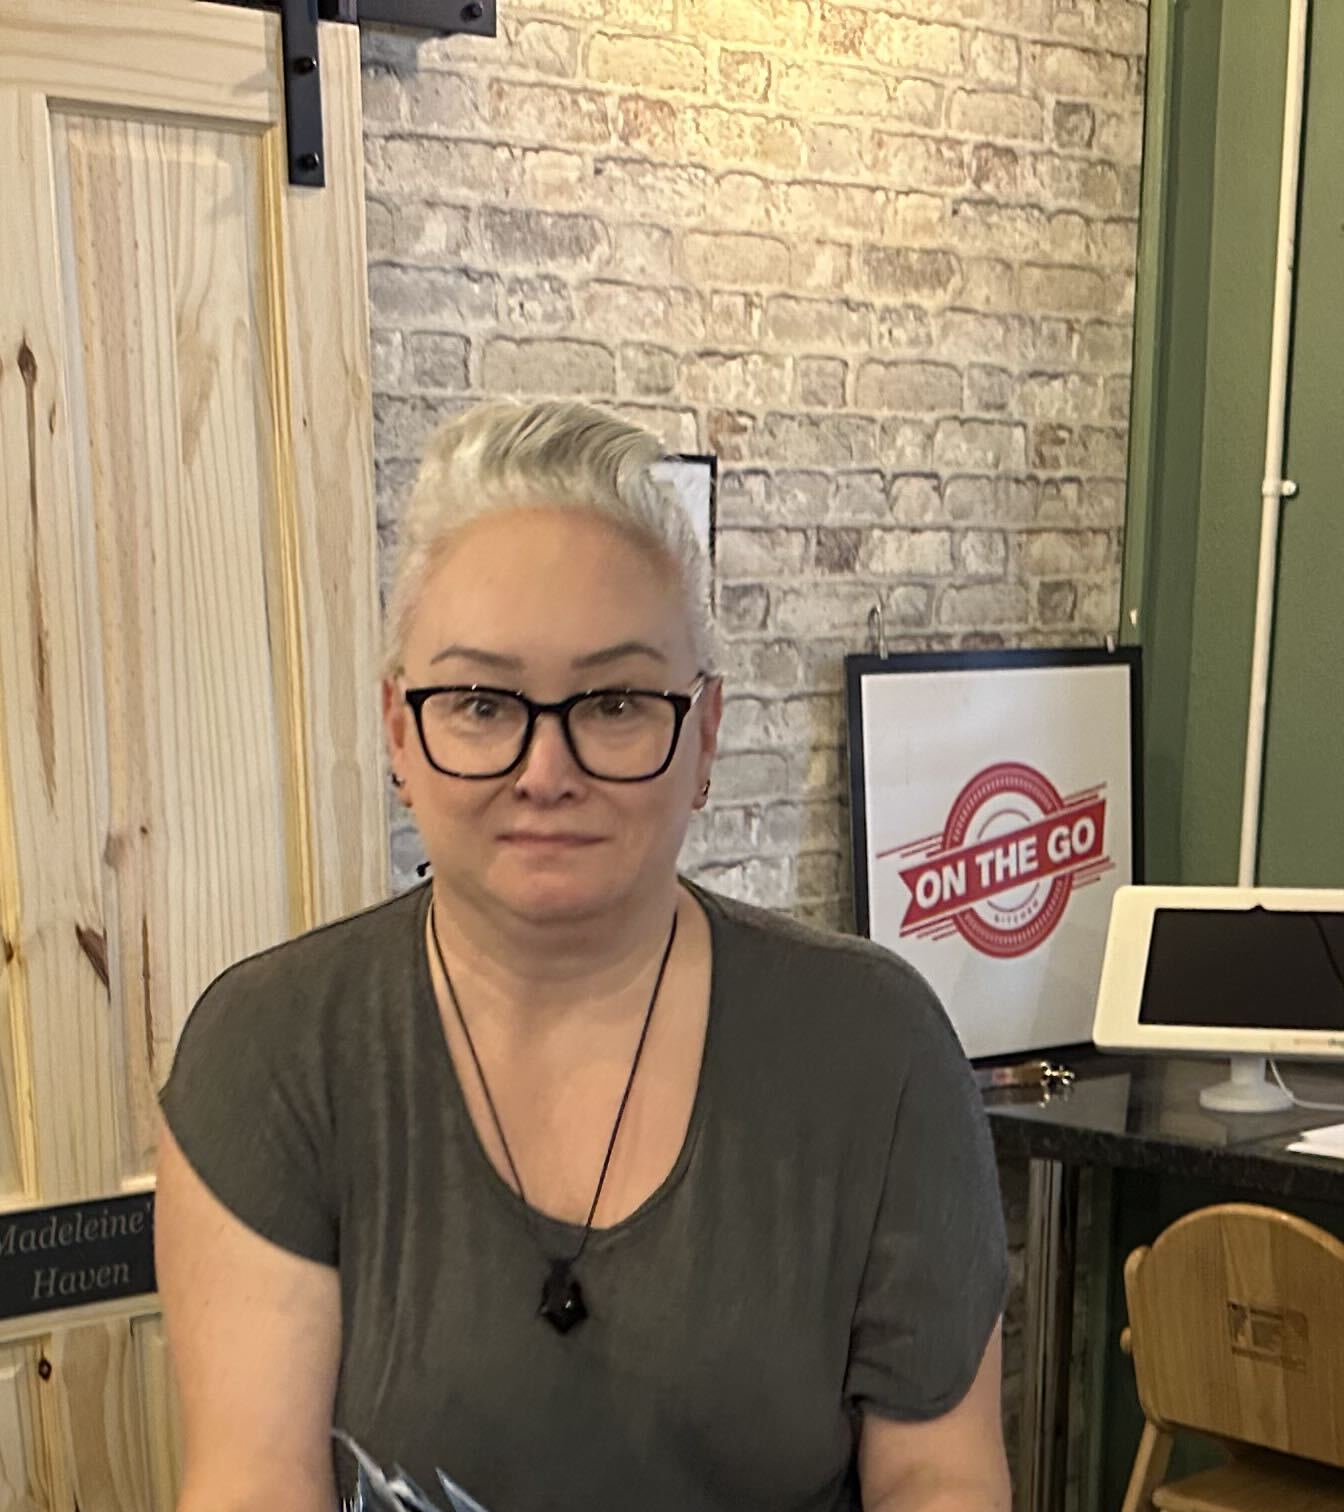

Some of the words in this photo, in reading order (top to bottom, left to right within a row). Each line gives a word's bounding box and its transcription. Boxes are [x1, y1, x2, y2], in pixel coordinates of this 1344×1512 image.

[915, 859, 967, 909] ON
[975, 836, 1040, 889] THE
[1047, 816, 1096, 861] GO
[31, 1261, 130, 1300] Haven
